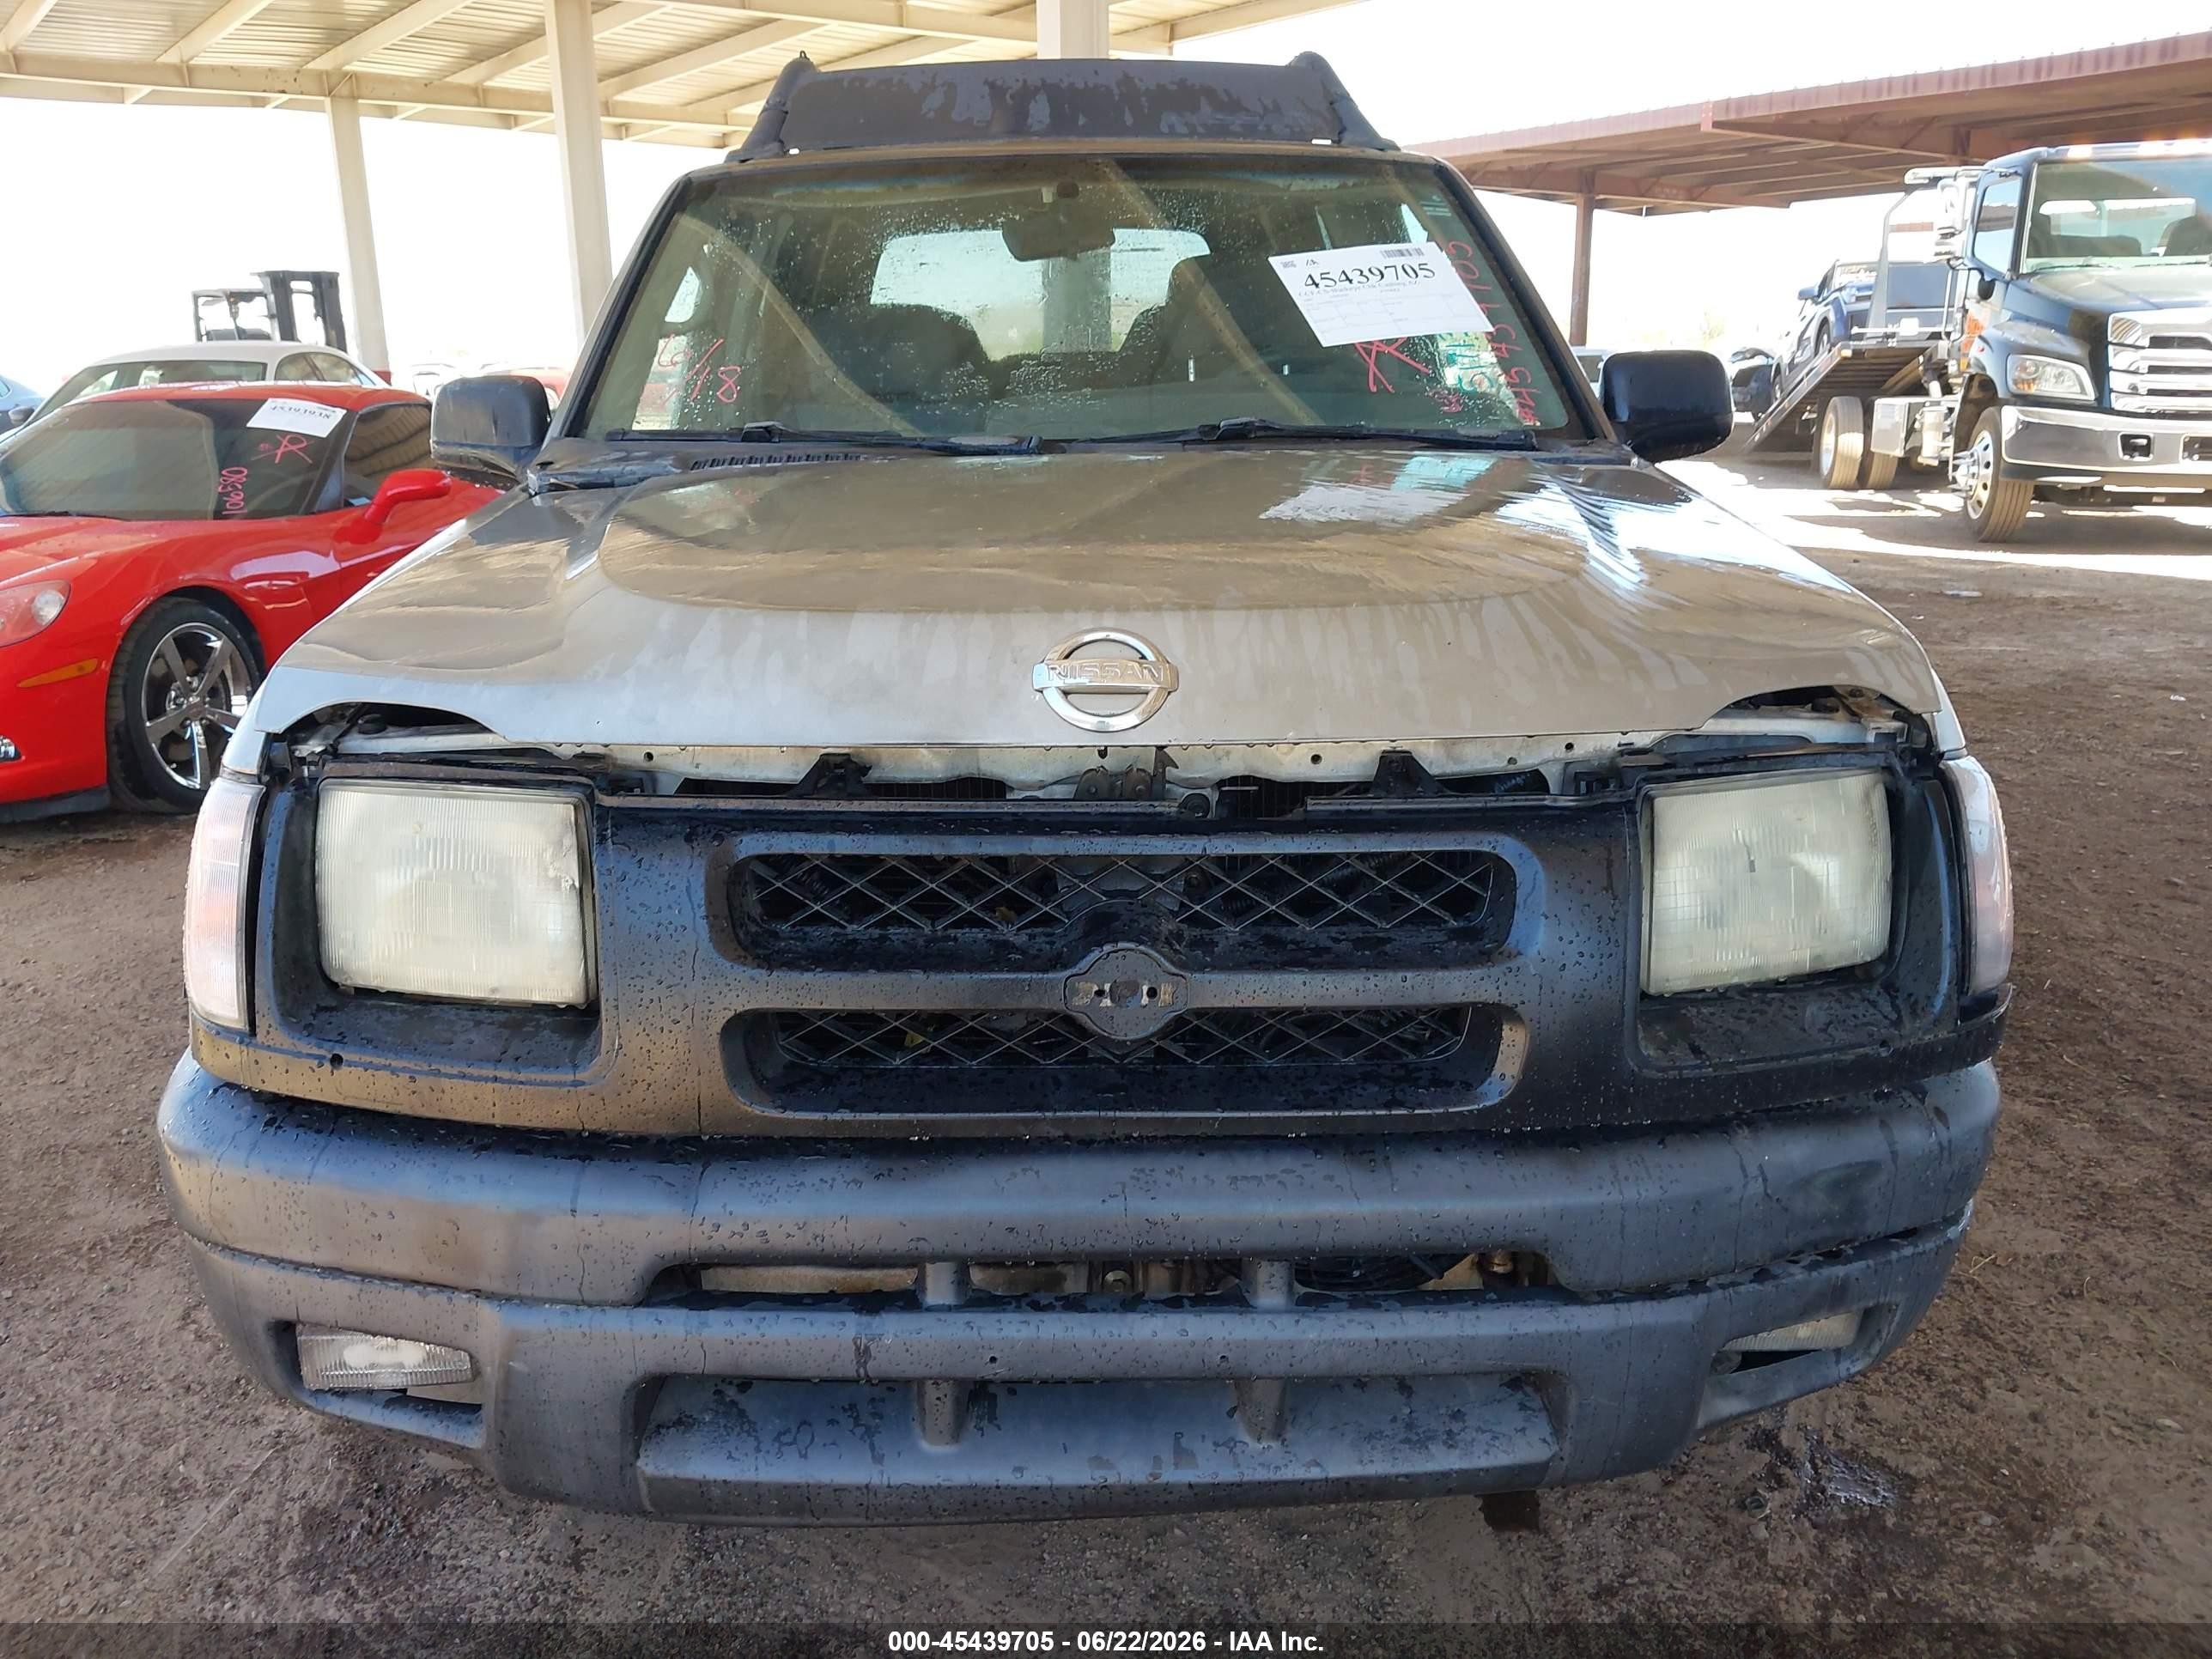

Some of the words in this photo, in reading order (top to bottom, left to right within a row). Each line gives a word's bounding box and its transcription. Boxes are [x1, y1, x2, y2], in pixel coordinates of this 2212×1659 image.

[1304, 262, 1436, 289] 45439705
[217, 466, 248, 515] 106580
[1048, 662, 1164, 682] NISSAN
